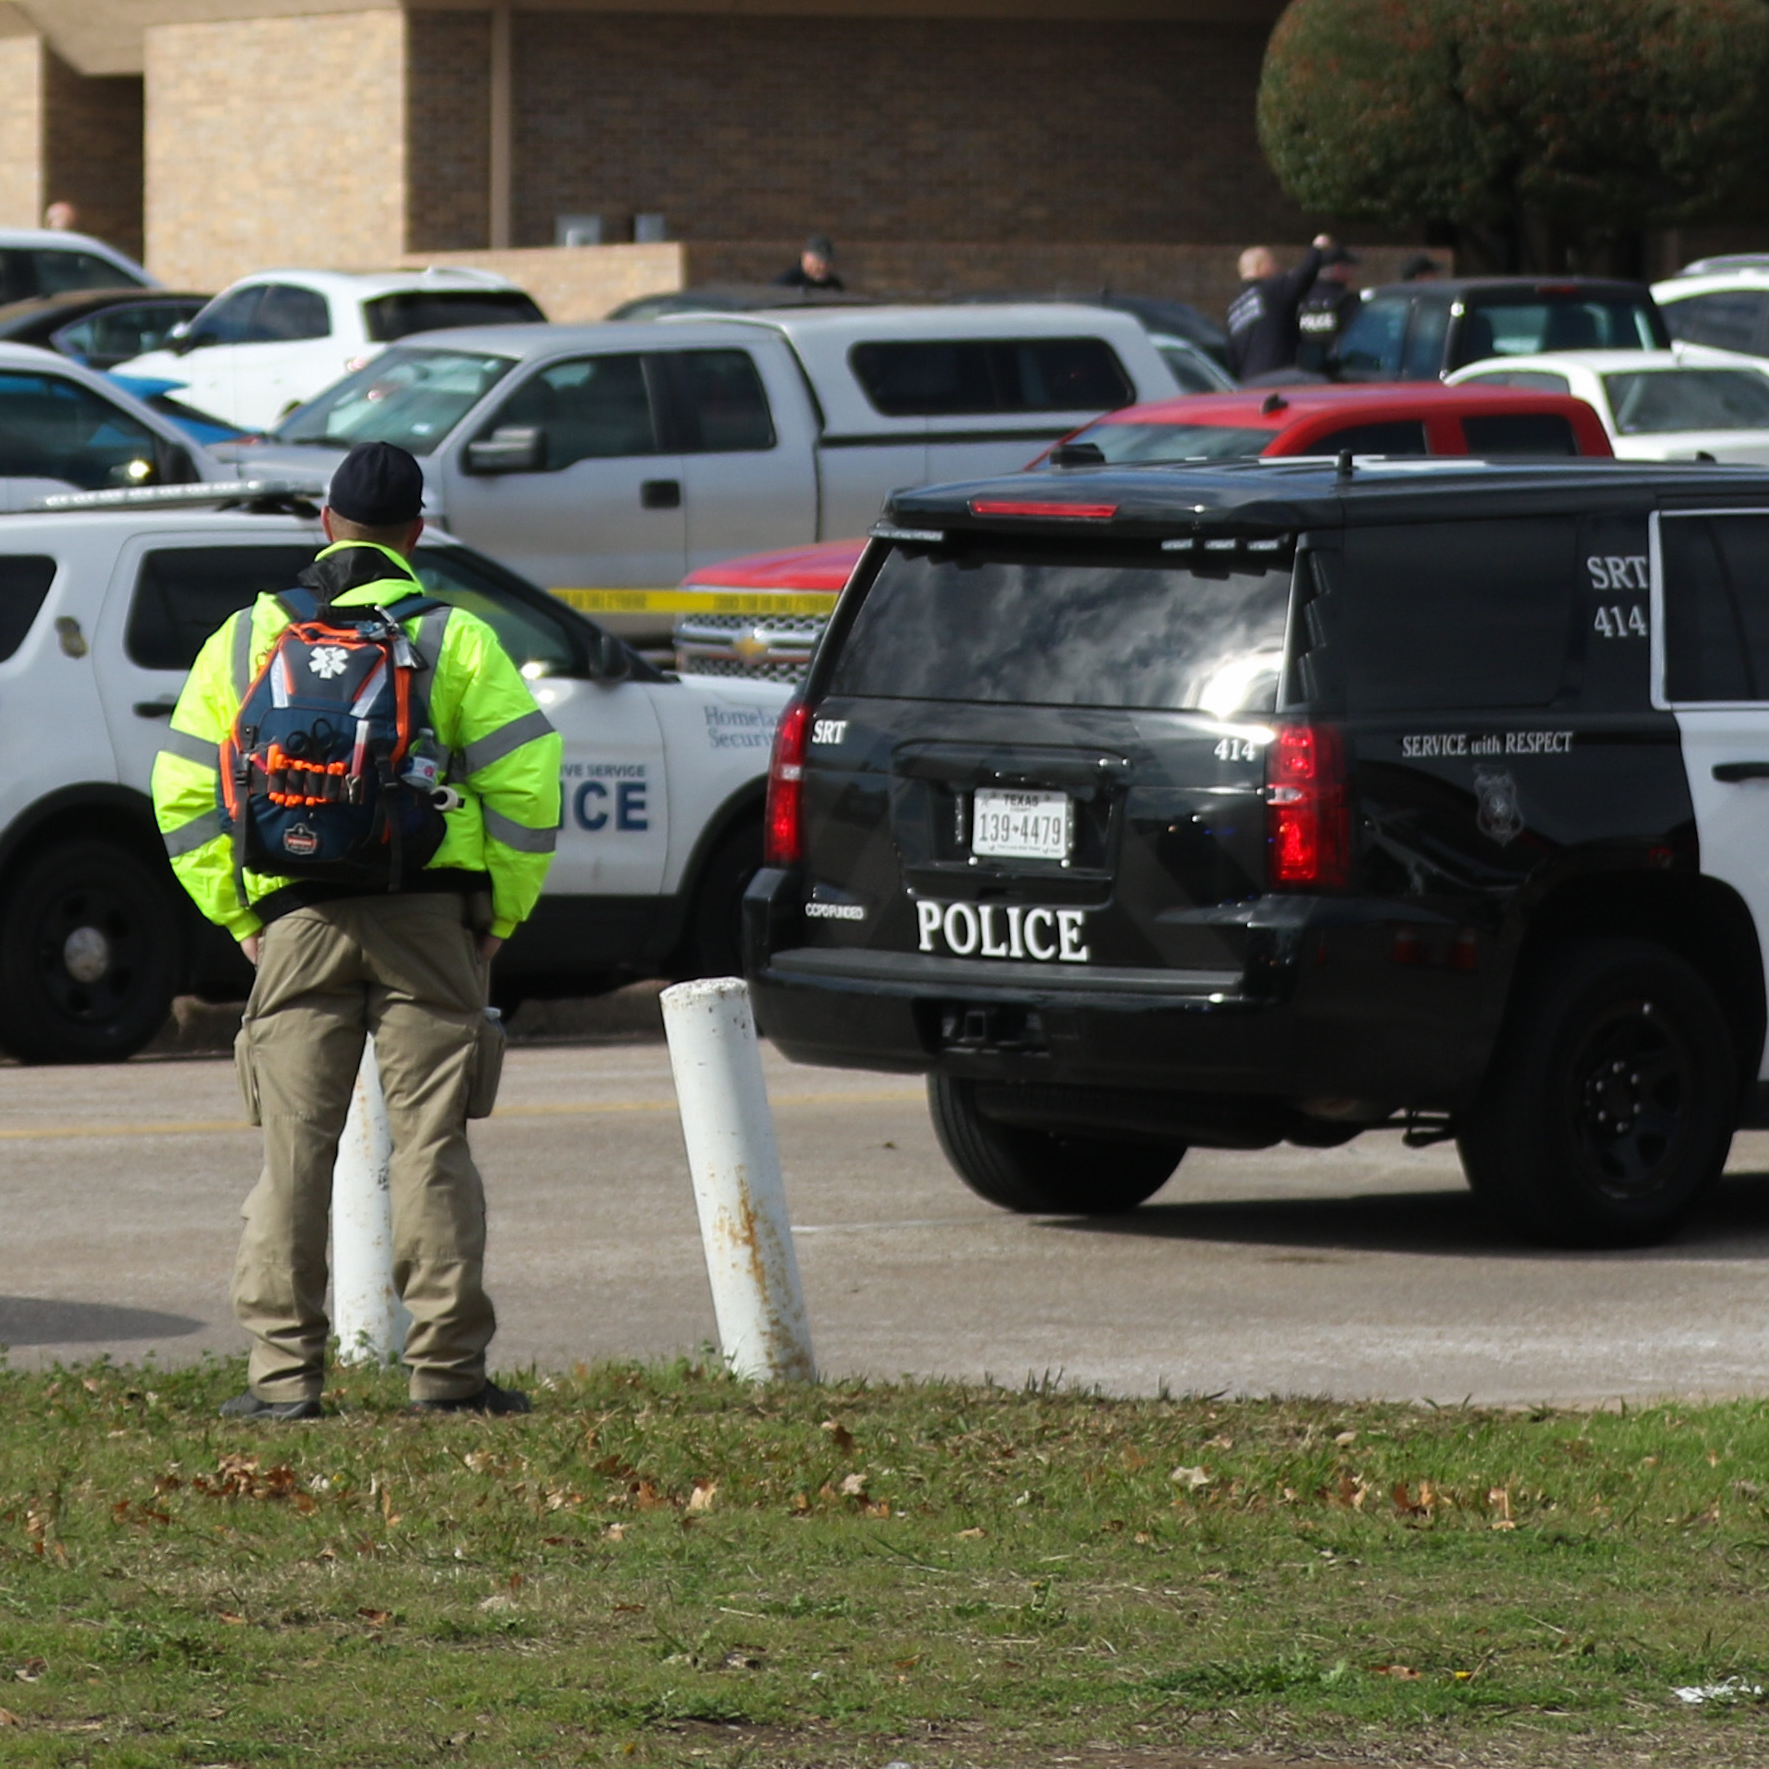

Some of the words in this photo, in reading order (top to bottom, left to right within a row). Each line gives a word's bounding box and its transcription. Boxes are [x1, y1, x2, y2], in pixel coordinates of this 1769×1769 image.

[1586, 555, 1648, 589] SRT
[1593, 605, 1647, 638] 414
[703, 705, 777, 727] Homela
[812, 719, 847, 744] SRT
[1402, 734, 1467, 758] SERVICE
[1471, 735, 1501, 754] with
[1505, 731, 1573, 754] RESPECT
[1214, 738, 1256, 761] 414
[586, 764, 646, 777] SERVICE
[916, 900, 1090, 962] POLICE
